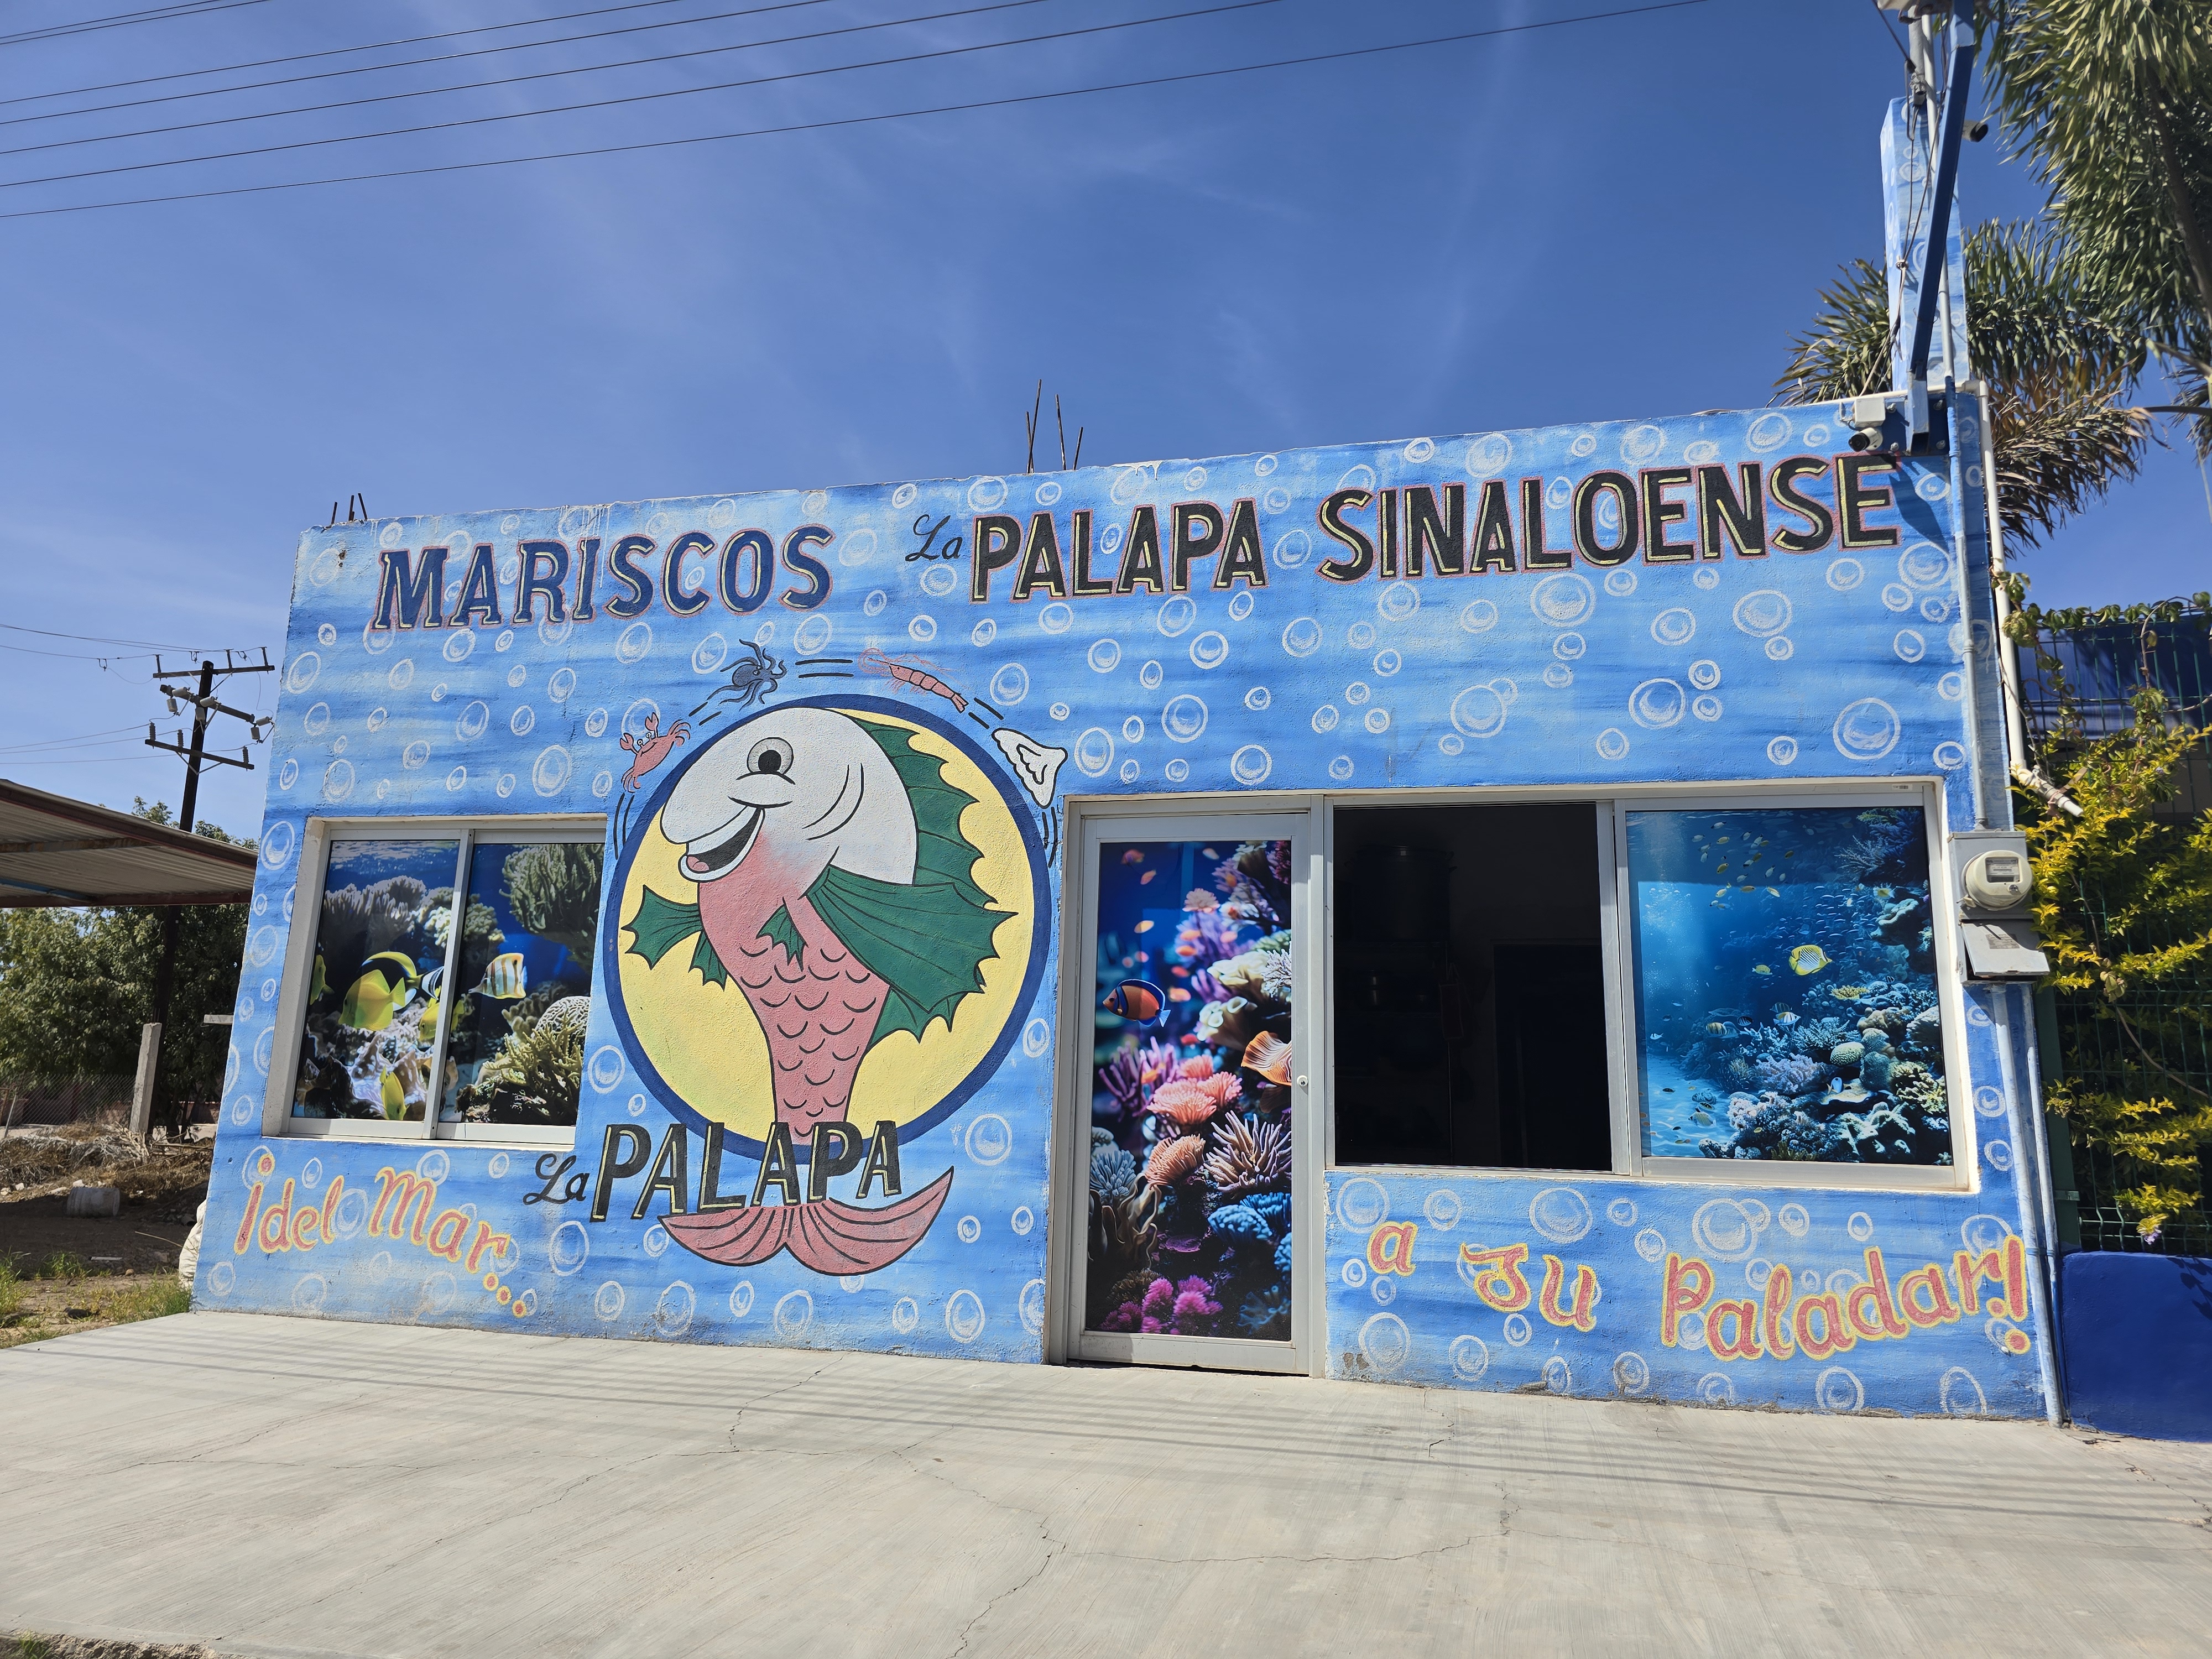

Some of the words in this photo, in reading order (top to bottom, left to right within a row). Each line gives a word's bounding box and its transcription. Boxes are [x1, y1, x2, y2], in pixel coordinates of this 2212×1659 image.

[370, 523, 836, 632] MARISCOS
[905, 514, 963, 562] La
[970, 497, 1269, 603] PALAPA
[1317, 452, 1902, 585] SINALOENSE
[523, 1153, 590, 1205] La
[589, 1120, 902, 1223] PALAPA
[1367, 1220, 1418, 1277] a
